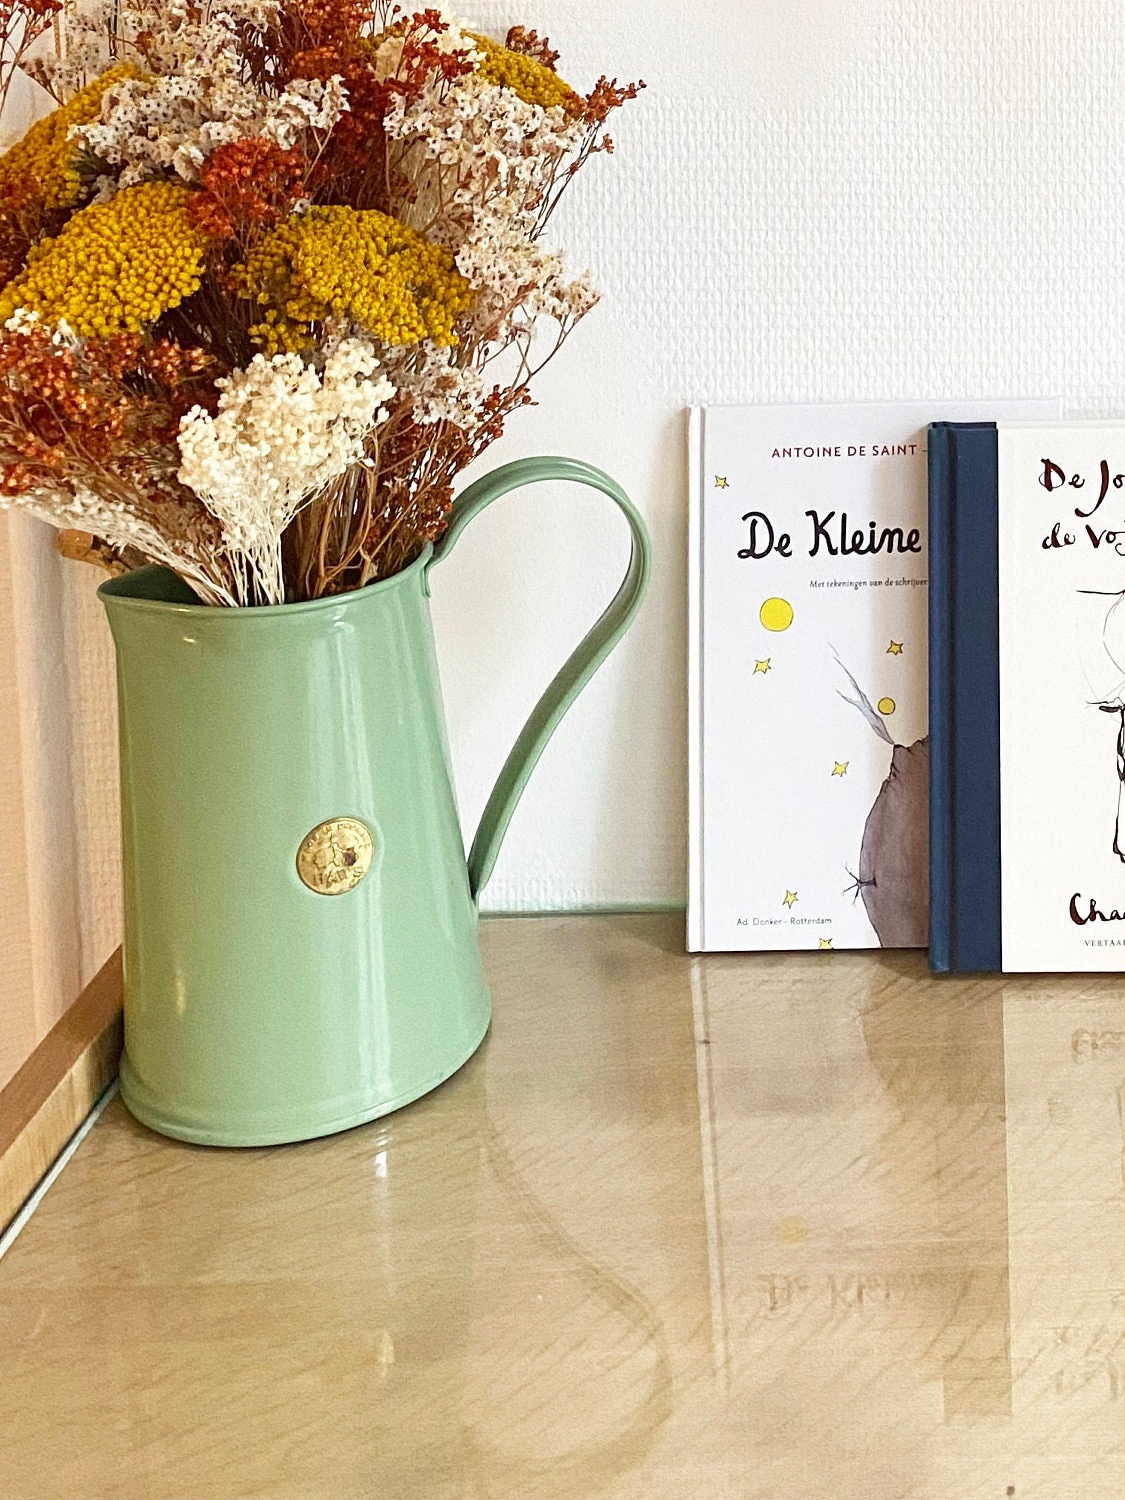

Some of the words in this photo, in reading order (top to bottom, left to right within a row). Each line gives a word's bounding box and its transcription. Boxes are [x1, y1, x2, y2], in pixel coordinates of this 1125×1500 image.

[771, 446, 842, 459] ANTOINE
[847, 445, 866, 457] DE
[872, 444, 918, 457] SAINT
[1038, 458, 1085, 492] De
[737, 510, 793, 560] De
[805, 509, 922, 557] Kleine
[1041, 522, 1077, 550] de
[809, 579, 825, 588] Met
[826, 578, 868, 591] tekeningen
[884, 577, 894, 587] de
[790, 916, 832, 926] Rotterdam
